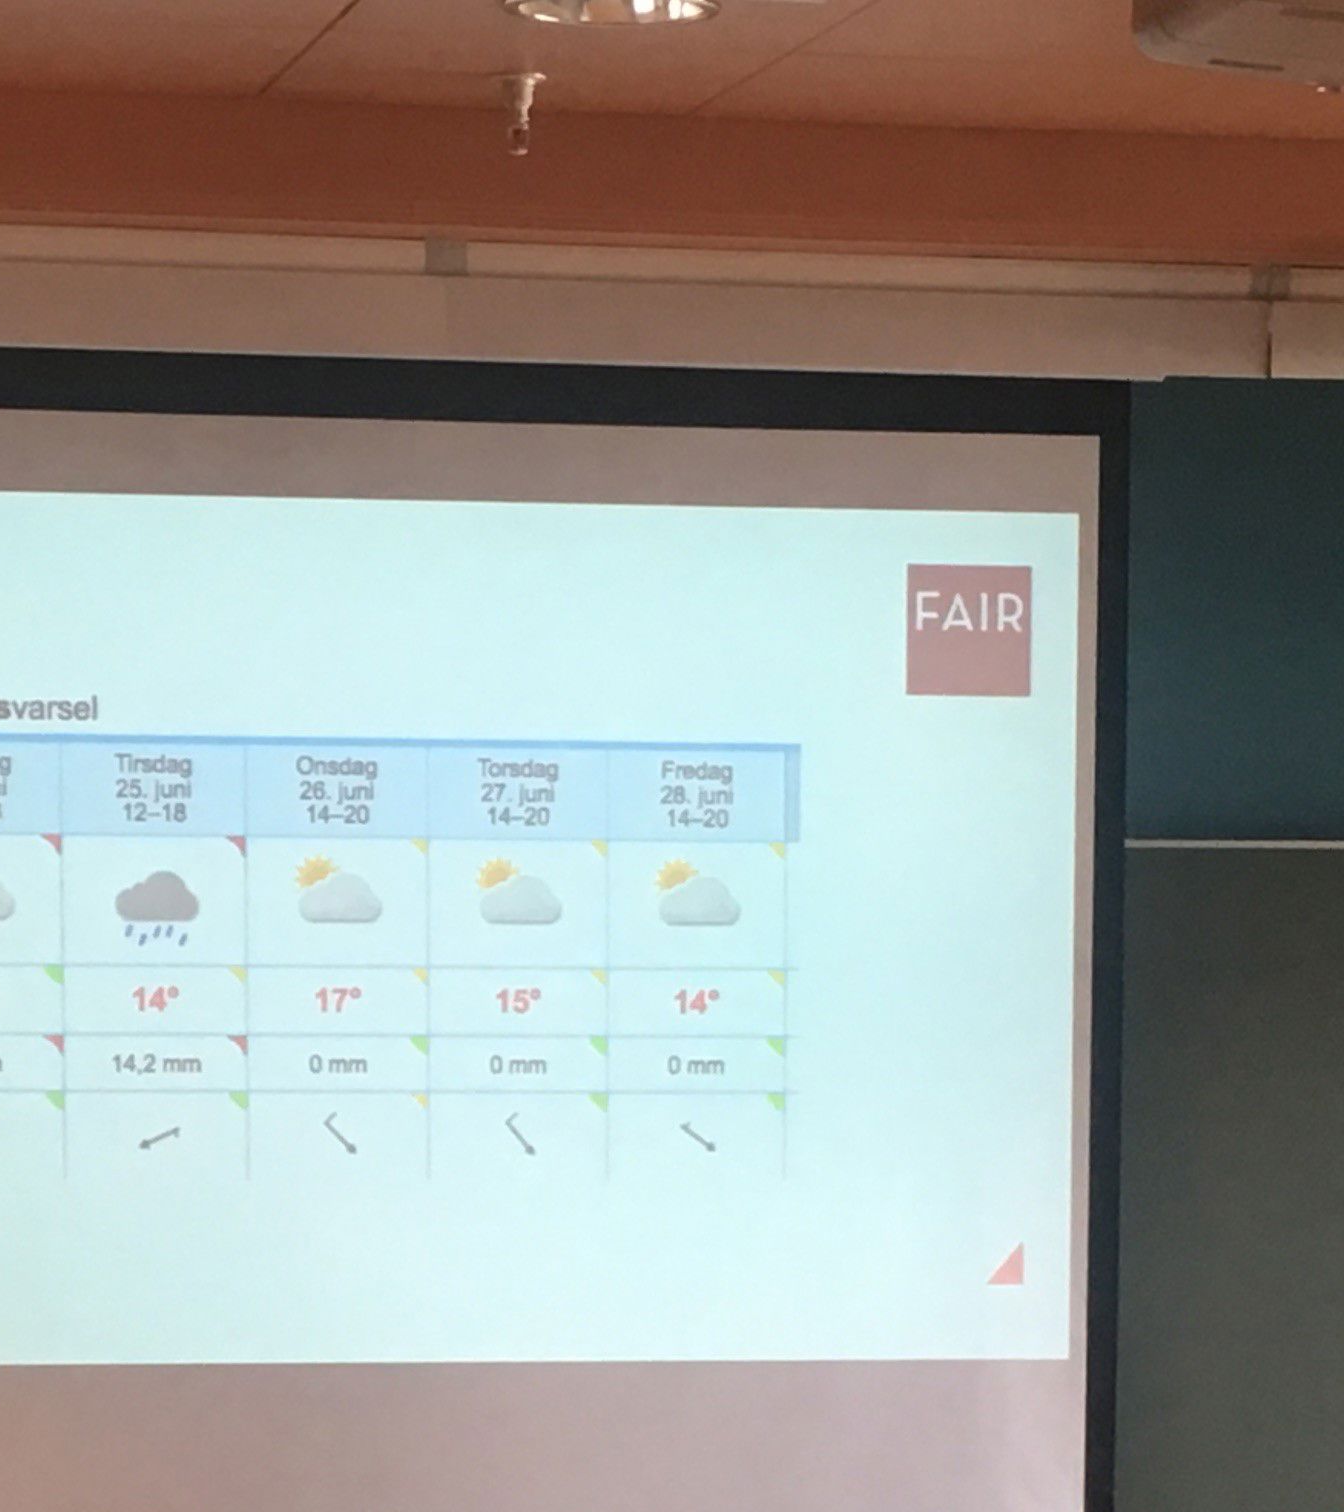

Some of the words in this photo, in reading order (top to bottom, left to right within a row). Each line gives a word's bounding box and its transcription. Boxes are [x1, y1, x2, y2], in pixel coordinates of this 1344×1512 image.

[916, 591, 1024, 633] FAIR
[114, 754, 193, 778] Tirsdag
[295, 757, 378, 781] Onsdag
[477, 758, 560, 783] Torsdag
[661, 760, 734, 785] Fredag
[115, 778, 149, 798] 25.
[154, 778, 192, 802] juni
[299, 781, 332, 801] 26.
[338, 780, 375, 805] juni
[481, 783, 514, 803] 27.
[519, 782, 556, 806] juni
[660, 785, 692, 805] 28.
[697, 785, 734, 809] juni
[112, 1054, 157, 1076] 14,2
[162, 1055, 202, 1074] mm
[309, 1055, 323, 1074] 0
[329, 1056, 368, 1074] mm
[490, 1056, 504, 1075] 0
[508, 1057, 548, 1075] mm
[667, 1056, 681, 1076] 0
[687, 1058, 725, 1076] mm
